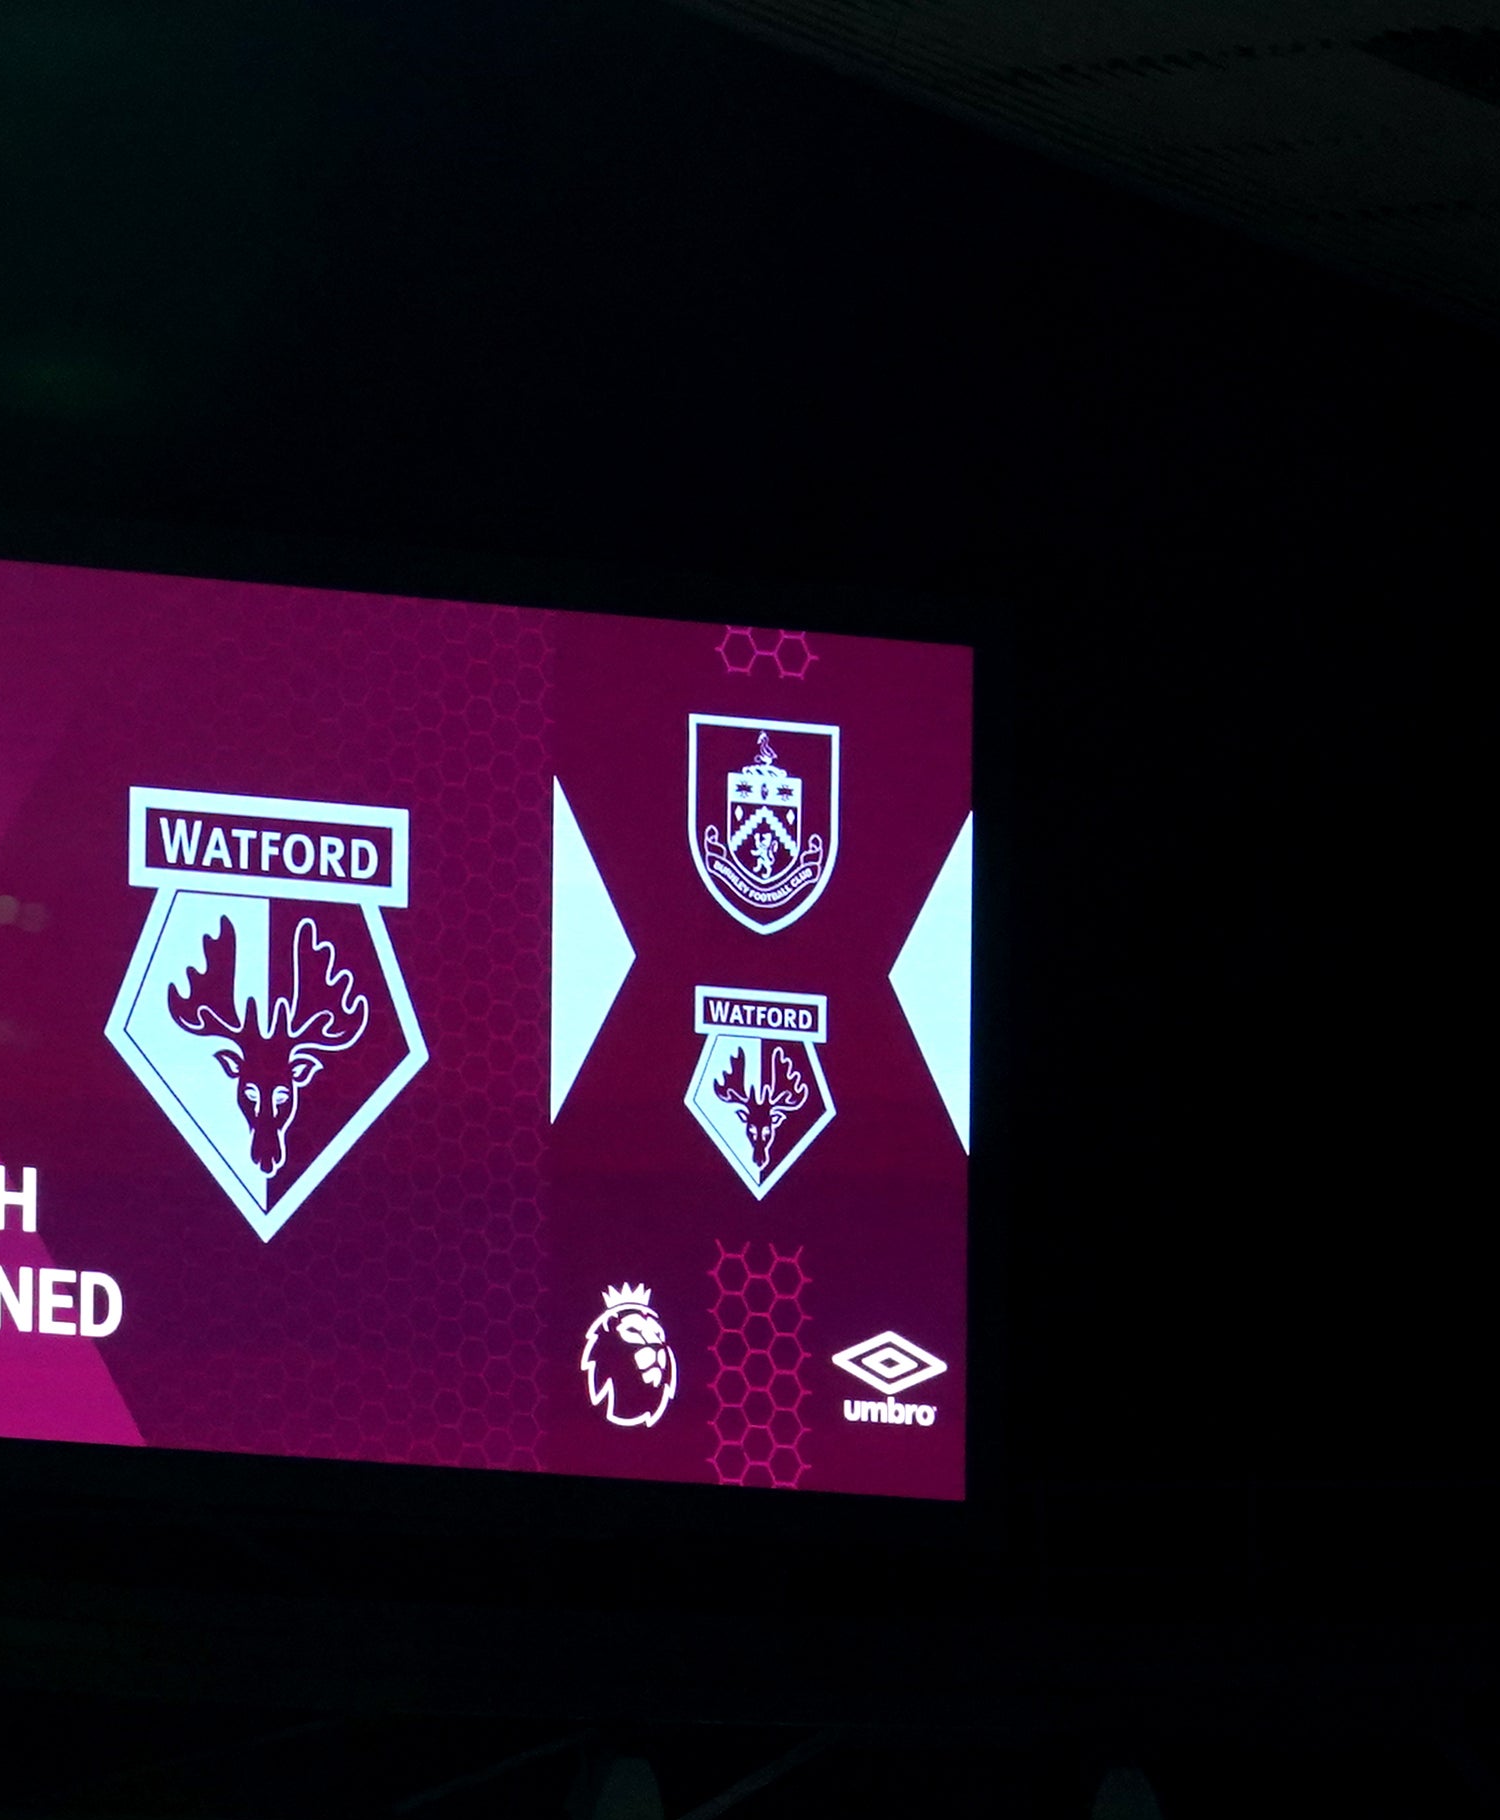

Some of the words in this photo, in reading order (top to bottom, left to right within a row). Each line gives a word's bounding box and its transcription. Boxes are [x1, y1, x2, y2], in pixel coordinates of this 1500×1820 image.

[158, 816, 379, 881] WATFORD
[708, 999, 813, 1031] WATFORD
[842, 1396, 936, 1427] umbro
